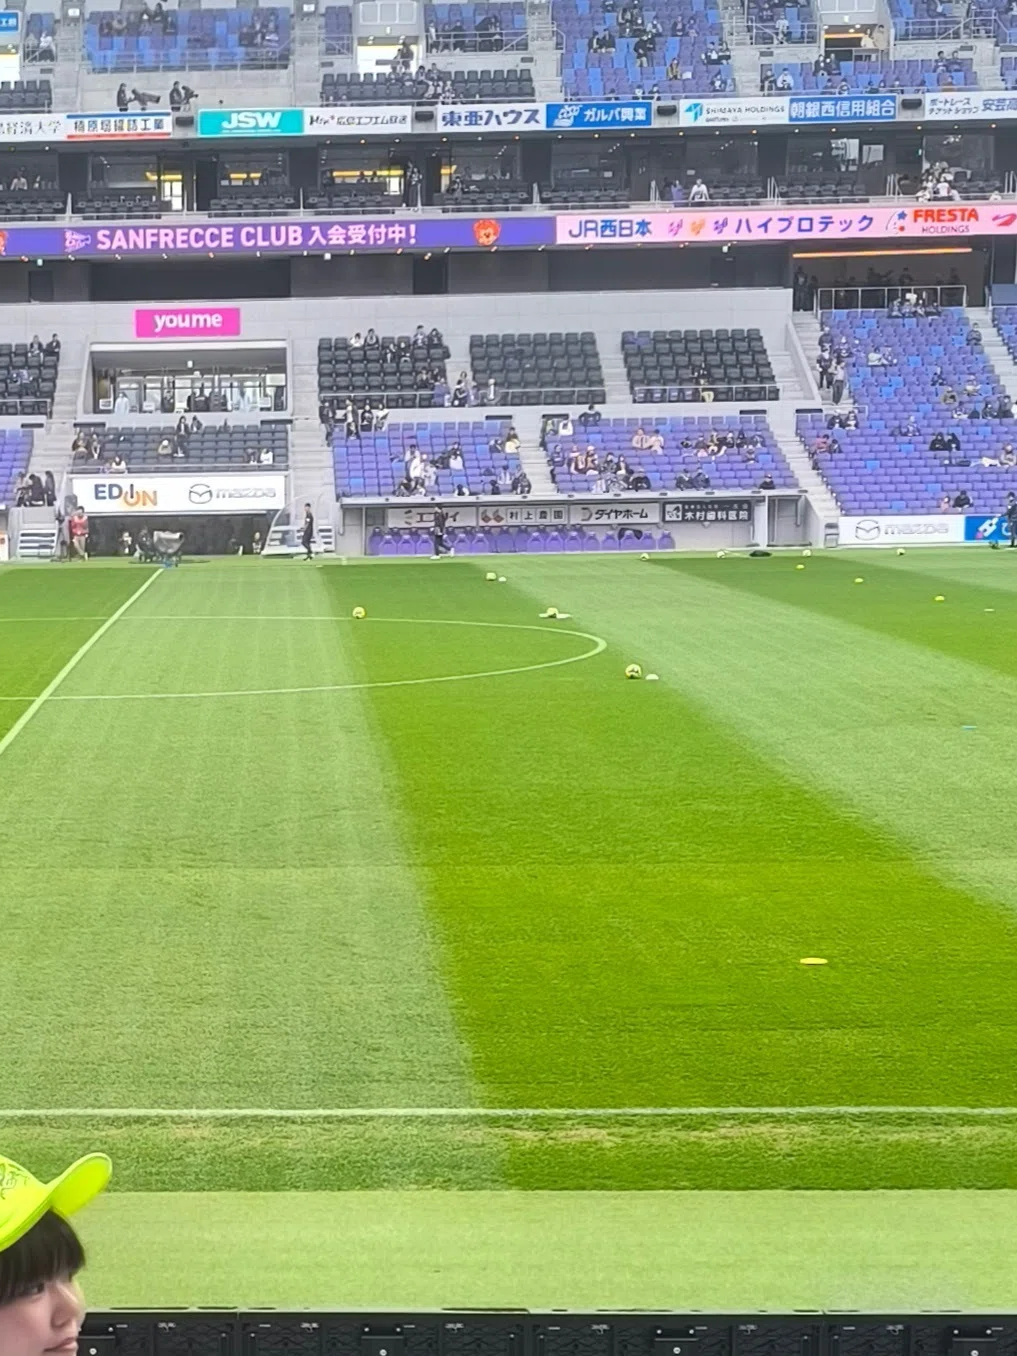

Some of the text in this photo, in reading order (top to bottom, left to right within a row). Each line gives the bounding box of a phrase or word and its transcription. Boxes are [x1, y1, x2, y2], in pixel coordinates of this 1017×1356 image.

[441, 109, 541, 127] 東亜ハウス
[790, 100, 895, 118] 朝銀西信用組合
[222, 111, 282, 129] JSW
[735, 214, 874, 234] ハイプロテック
[914, 208, 979, 224] FRESTA
[96, 226, 235, 250] SANFRECCE
[240, 225, 303, 247] CLUB
[569, 219, 653, 238] JR西日本
[922, 224, 970, 234] HOLDINGS
[153, 313, 223, 332] youme
[94, 483, 158, 507] EDION
[509, 509, 564, 520] 村上農園
[595, 508, 648, 520] ダイヤホーム
[684, 511, 749, 520] 木村歯科医院
